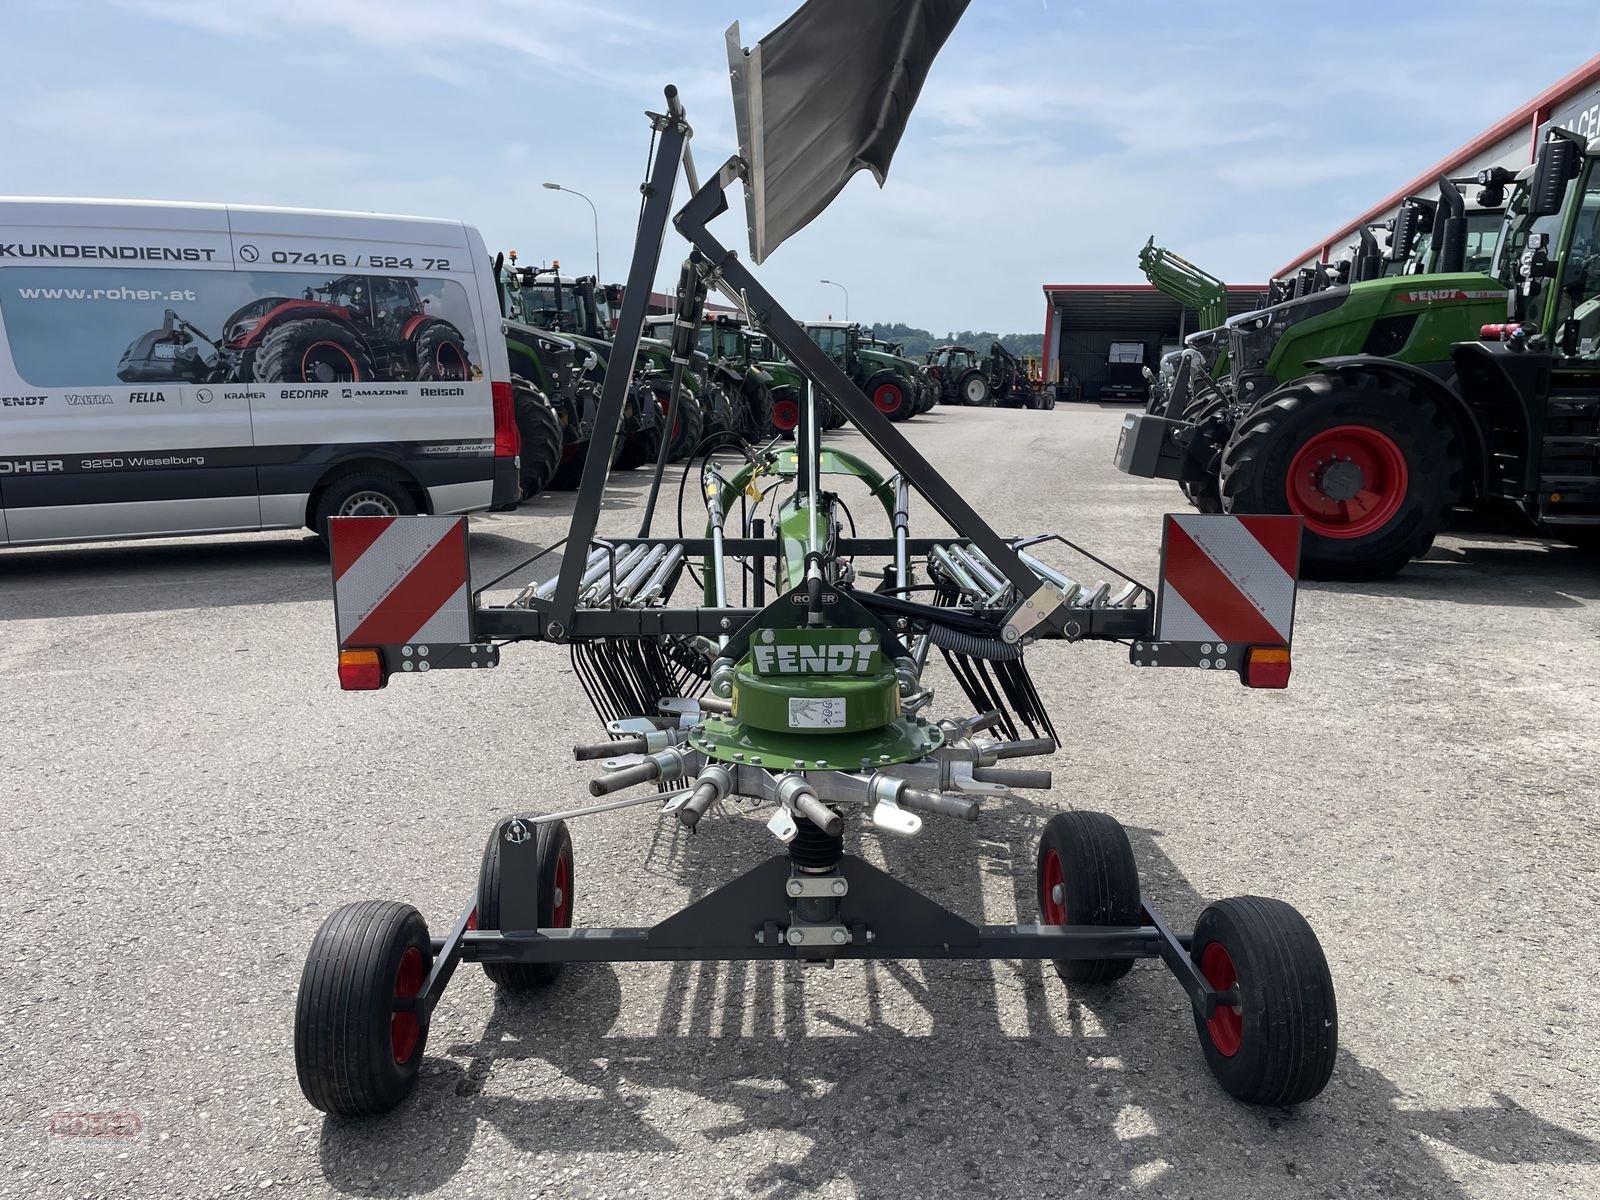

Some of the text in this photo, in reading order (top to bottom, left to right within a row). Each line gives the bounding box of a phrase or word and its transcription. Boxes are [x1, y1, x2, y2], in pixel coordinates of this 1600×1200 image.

[0, 243, 215, 261] KUNDENDIENST
[272, 251, 347, 266] 07416
[369, 256, 414, 269] 524
[422, 258, 450, 271] 72
[18, 286, 197, 301] www.roher.at
[1408, 288, 1460, 301] FENDT
[129, 392, 165, 403] FELLA
[224, 392, 266, 400] KRAMER
[280, 389, 329, 399] BEDNAR
[420, 387, 464, 397] Reisch
[0, 396, 48, 406] ENDT
[64, 394, 114, 406] VALTRA
[81, 456, 205, 470] 3250 Wieselburg
[793, 594, 836, 603] ROER
[754, 644, 879, 673] FENDT
